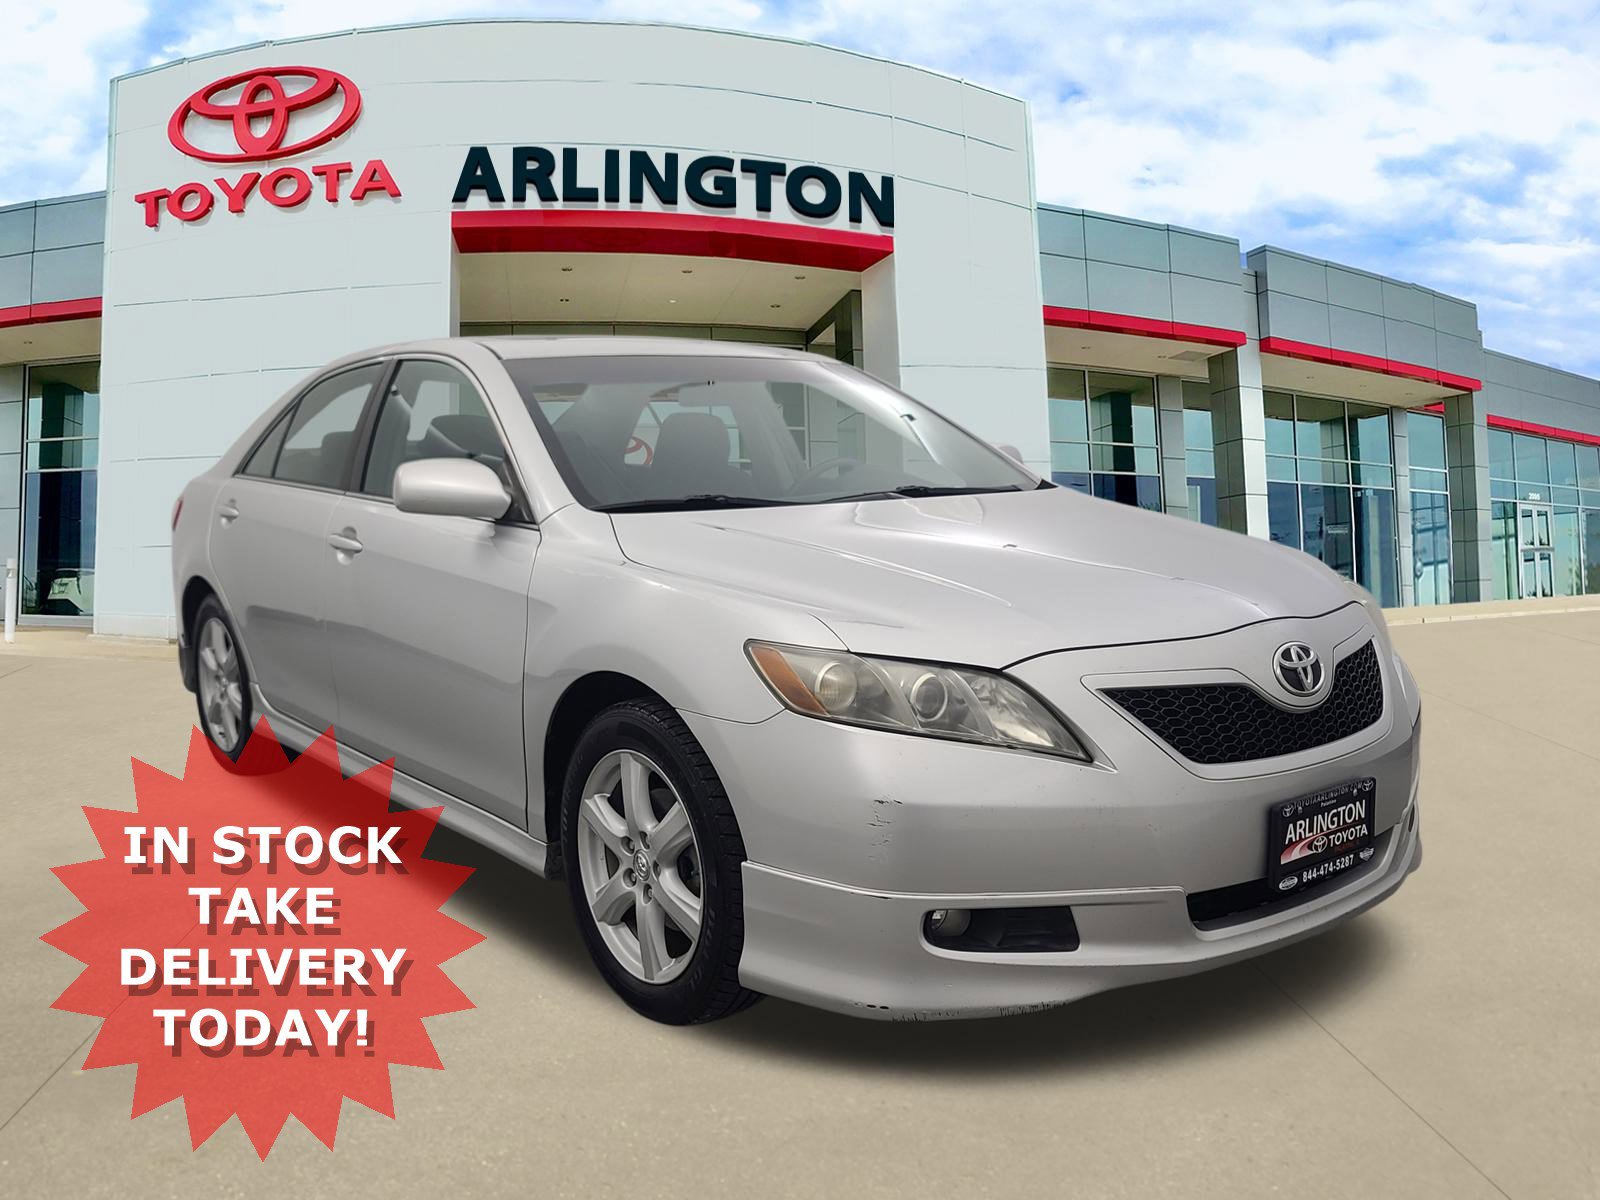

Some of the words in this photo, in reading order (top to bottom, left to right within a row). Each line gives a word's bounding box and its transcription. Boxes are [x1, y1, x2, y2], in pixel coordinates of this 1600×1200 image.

[135, 159, 401, 228] TOYOTA
[452, 146, 895, 229] ARLINGTON
[1285, 801, 1366, 845] ARLINGTON
[1329, 824, 1368, 847] TOYOTA
[1303, 855, 1354, 883] 844-474-5287
